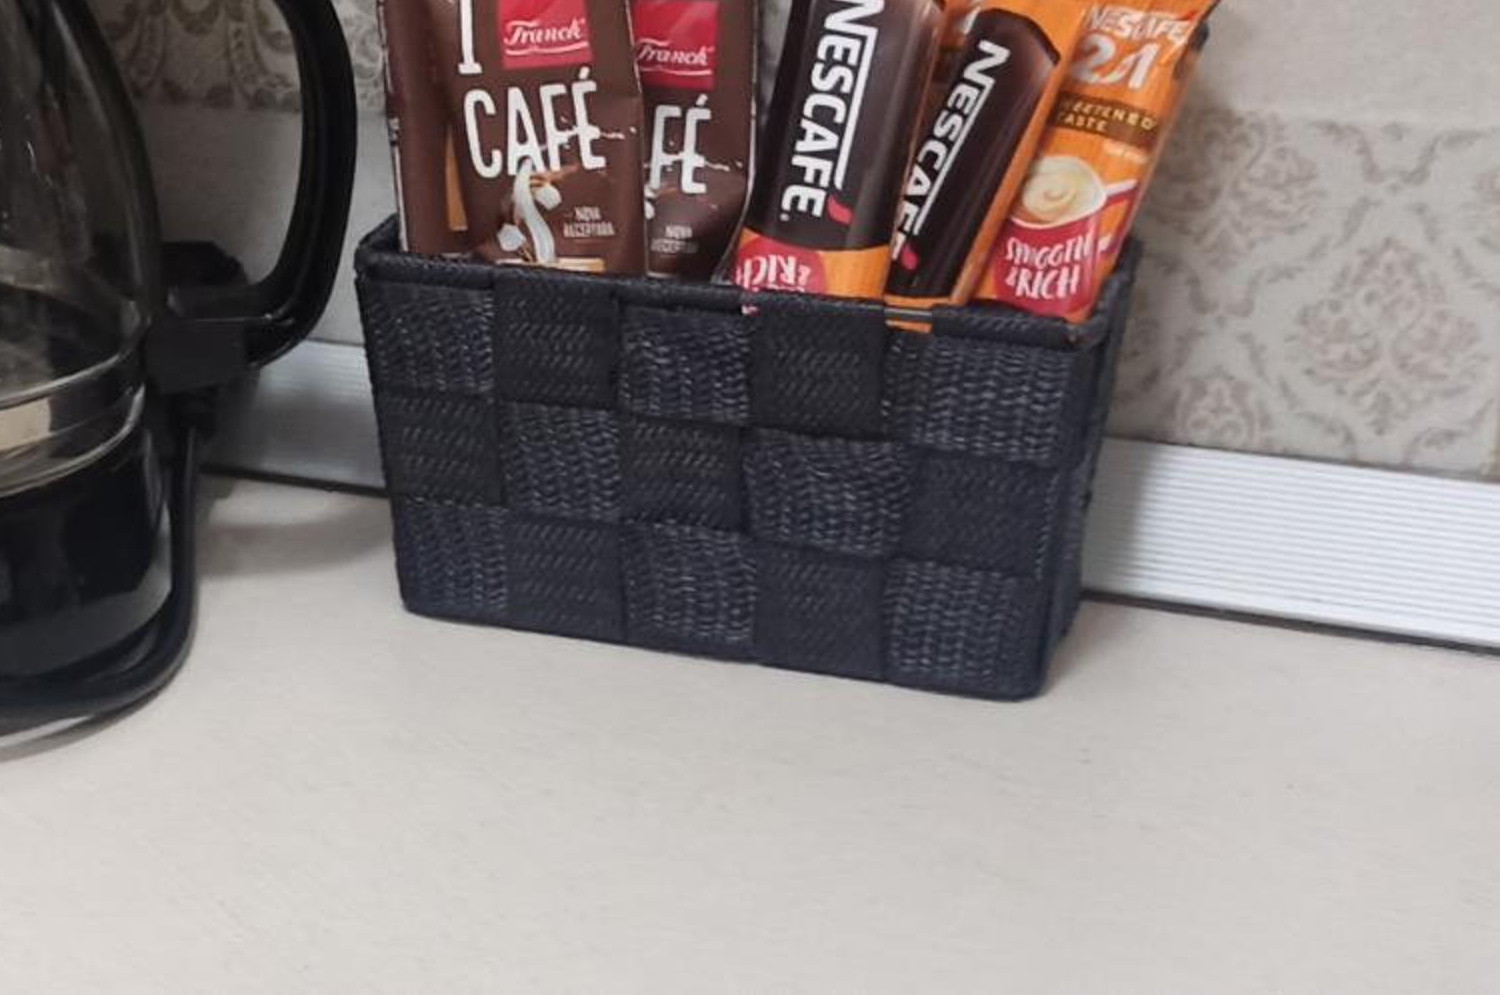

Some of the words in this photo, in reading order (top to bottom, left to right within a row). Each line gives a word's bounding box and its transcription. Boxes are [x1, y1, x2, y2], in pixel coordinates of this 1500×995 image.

[503, 18, 586, 46] Franck
[638, 37, 710, 66] Franck
[463, 66, 607, 179] CAFÉ
[650, 94, 711, 195] FÉ
